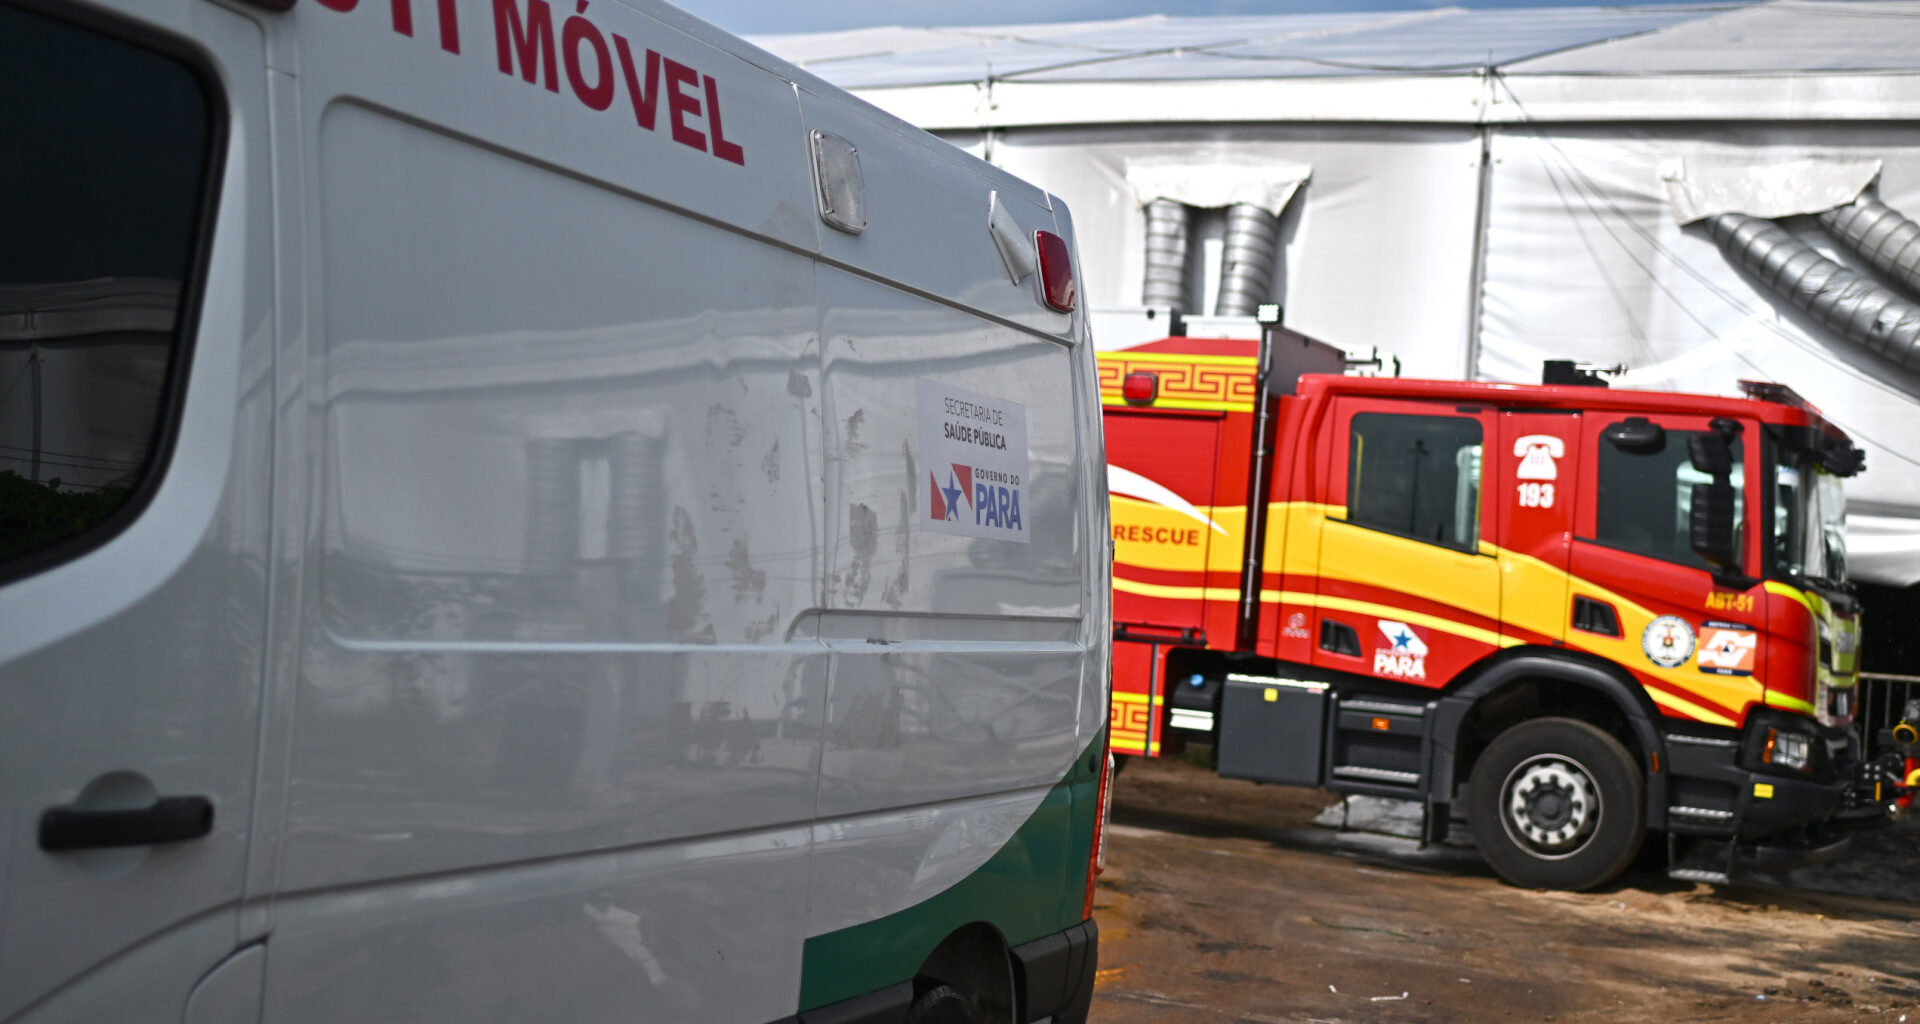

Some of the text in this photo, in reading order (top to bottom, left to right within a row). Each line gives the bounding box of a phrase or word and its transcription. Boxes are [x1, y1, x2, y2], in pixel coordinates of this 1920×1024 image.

[492, 0, 745, 167] MÓVEL
[944, 397, 1004, 427] SECRETARIA DE
[944, 421, 1007, 450] SAÚDE PÚBLICA
[975, 468, 1020, 486] GOVERNO DO
[976, 482, 1022, 530] PARÁ
[1517, 482, 1555, 509] 193
[1113, 524, 1199, 546] RESCUE
